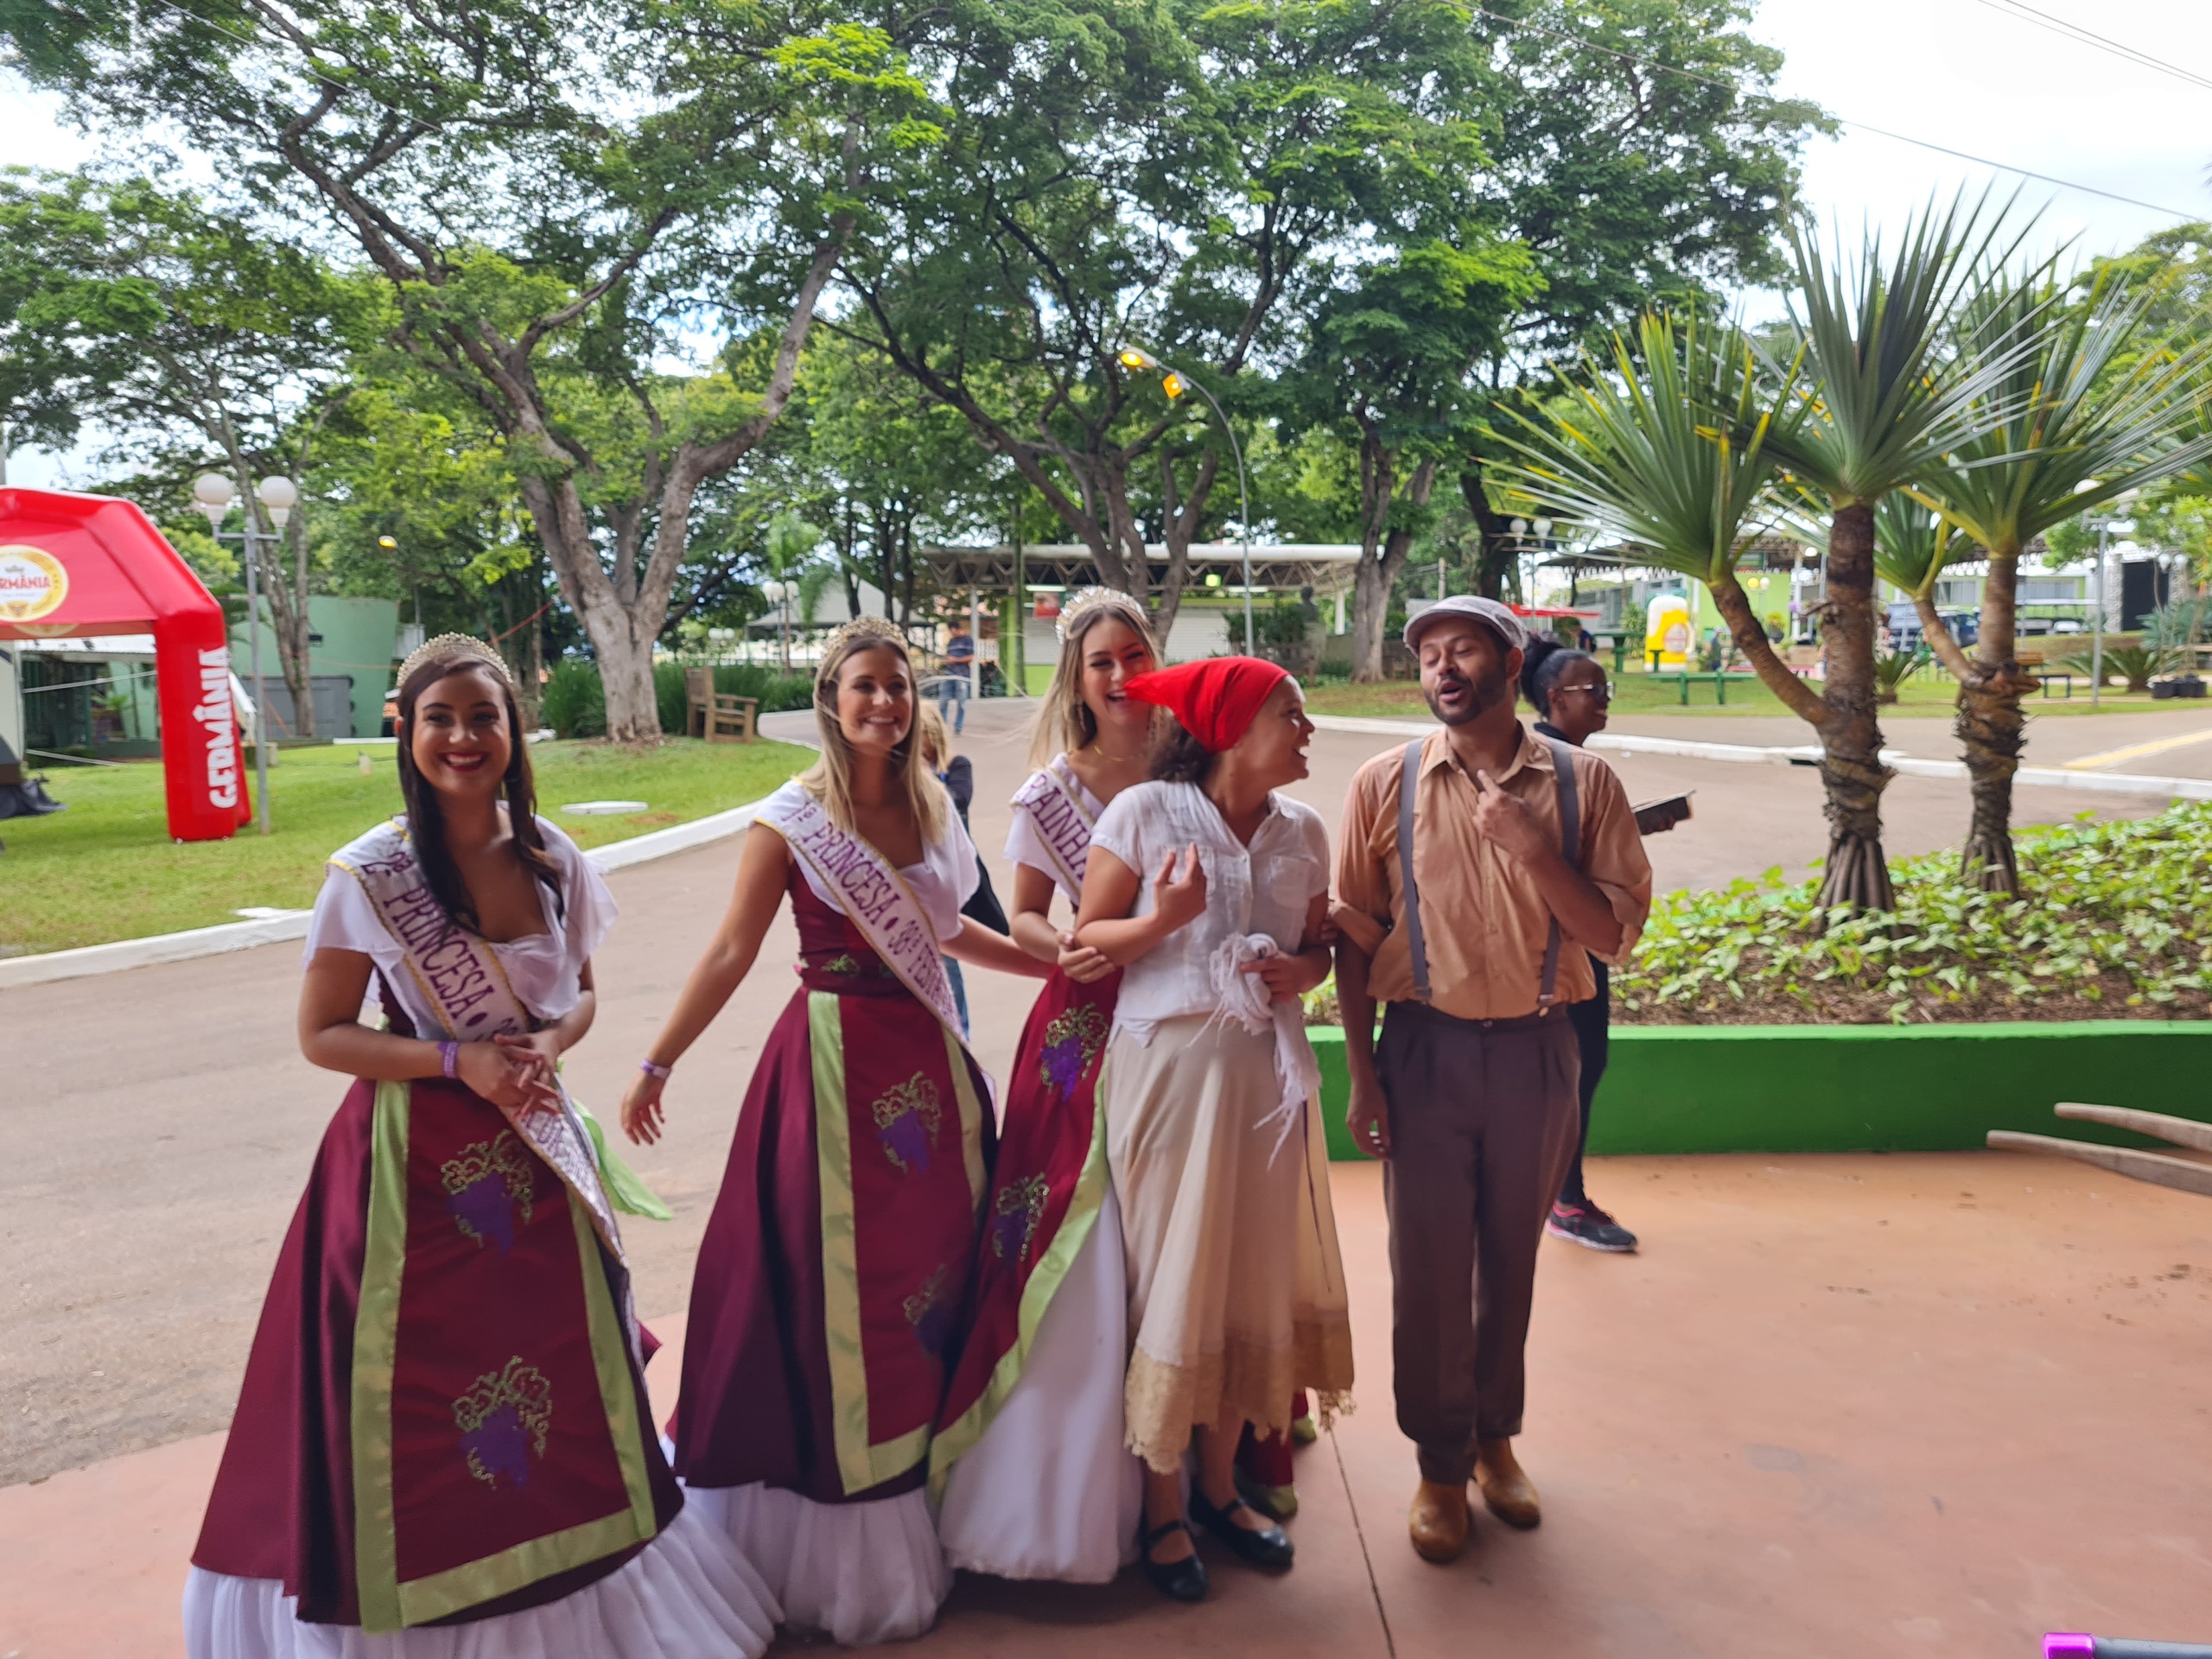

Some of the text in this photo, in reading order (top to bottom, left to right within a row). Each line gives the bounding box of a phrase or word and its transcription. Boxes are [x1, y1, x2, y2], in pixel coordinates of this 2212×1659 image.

[193, 646, 238, 808] GERMÂNIA
[803, 821, 900, 925] PRINCESA
[383, 883, 495, 1020] PRINCESA
